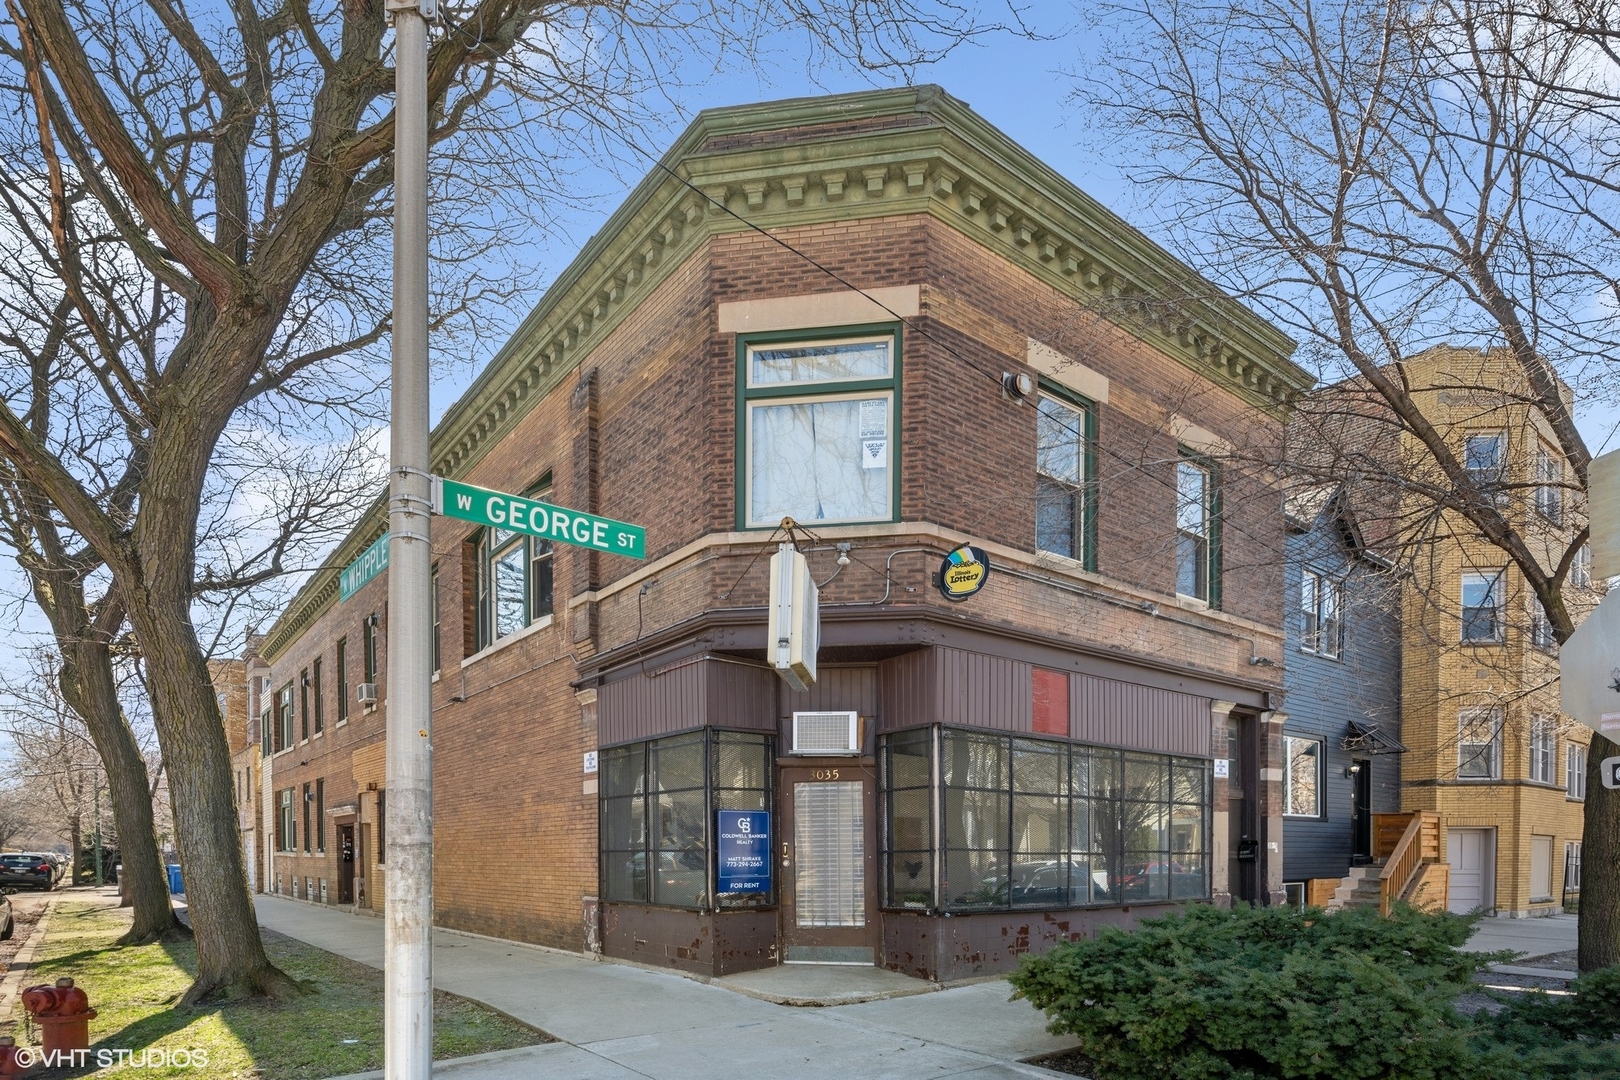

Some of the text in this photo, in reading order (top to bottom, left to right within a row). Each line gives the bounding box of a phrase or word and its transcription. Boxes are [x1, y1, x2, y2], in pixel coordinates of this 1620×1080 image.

[457, 493, 637, 549] W GEORGE ST
[349, 539, 388, 593] WHIPPLE
[950, 572, 979, 583] Lottery
[809, 769, 840, 781] 3035
